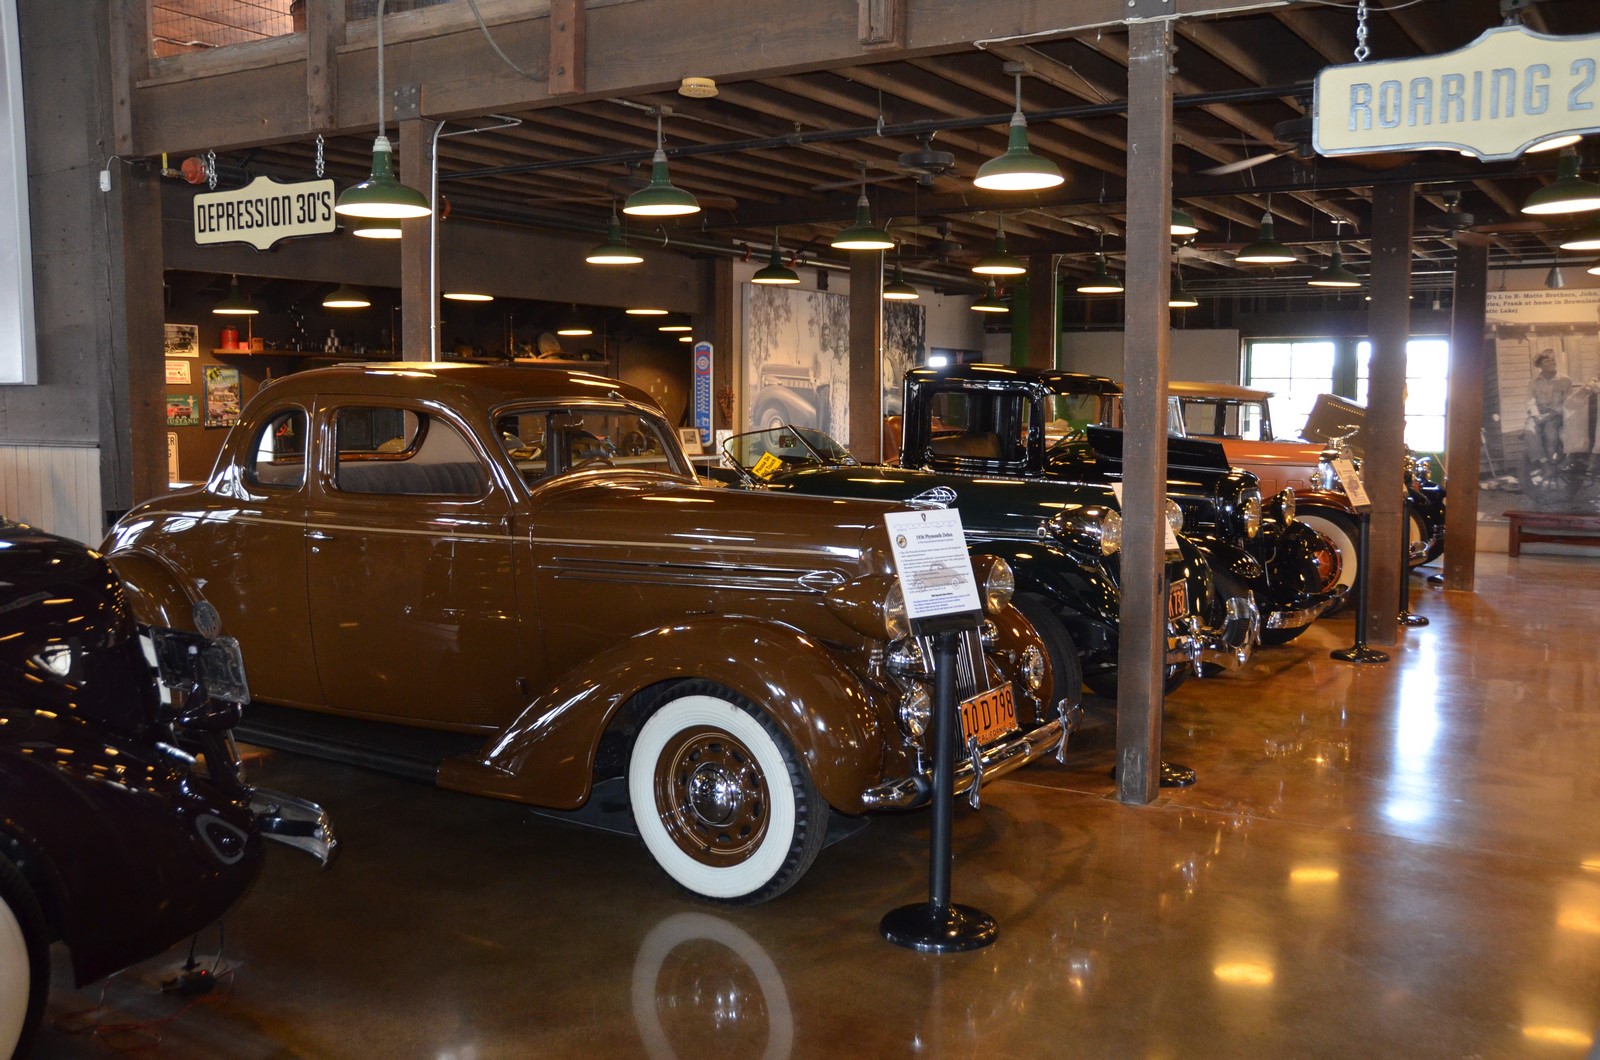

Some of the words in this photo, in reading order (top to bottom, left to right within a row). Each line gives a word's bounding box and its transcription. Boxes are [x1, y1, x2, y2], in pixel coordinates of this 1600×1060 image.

[1348, 63, 1551, 132] ROARING
[197, 195, 292, 234] DEPRESSION
[296, 190, 332, 224] 30'S
